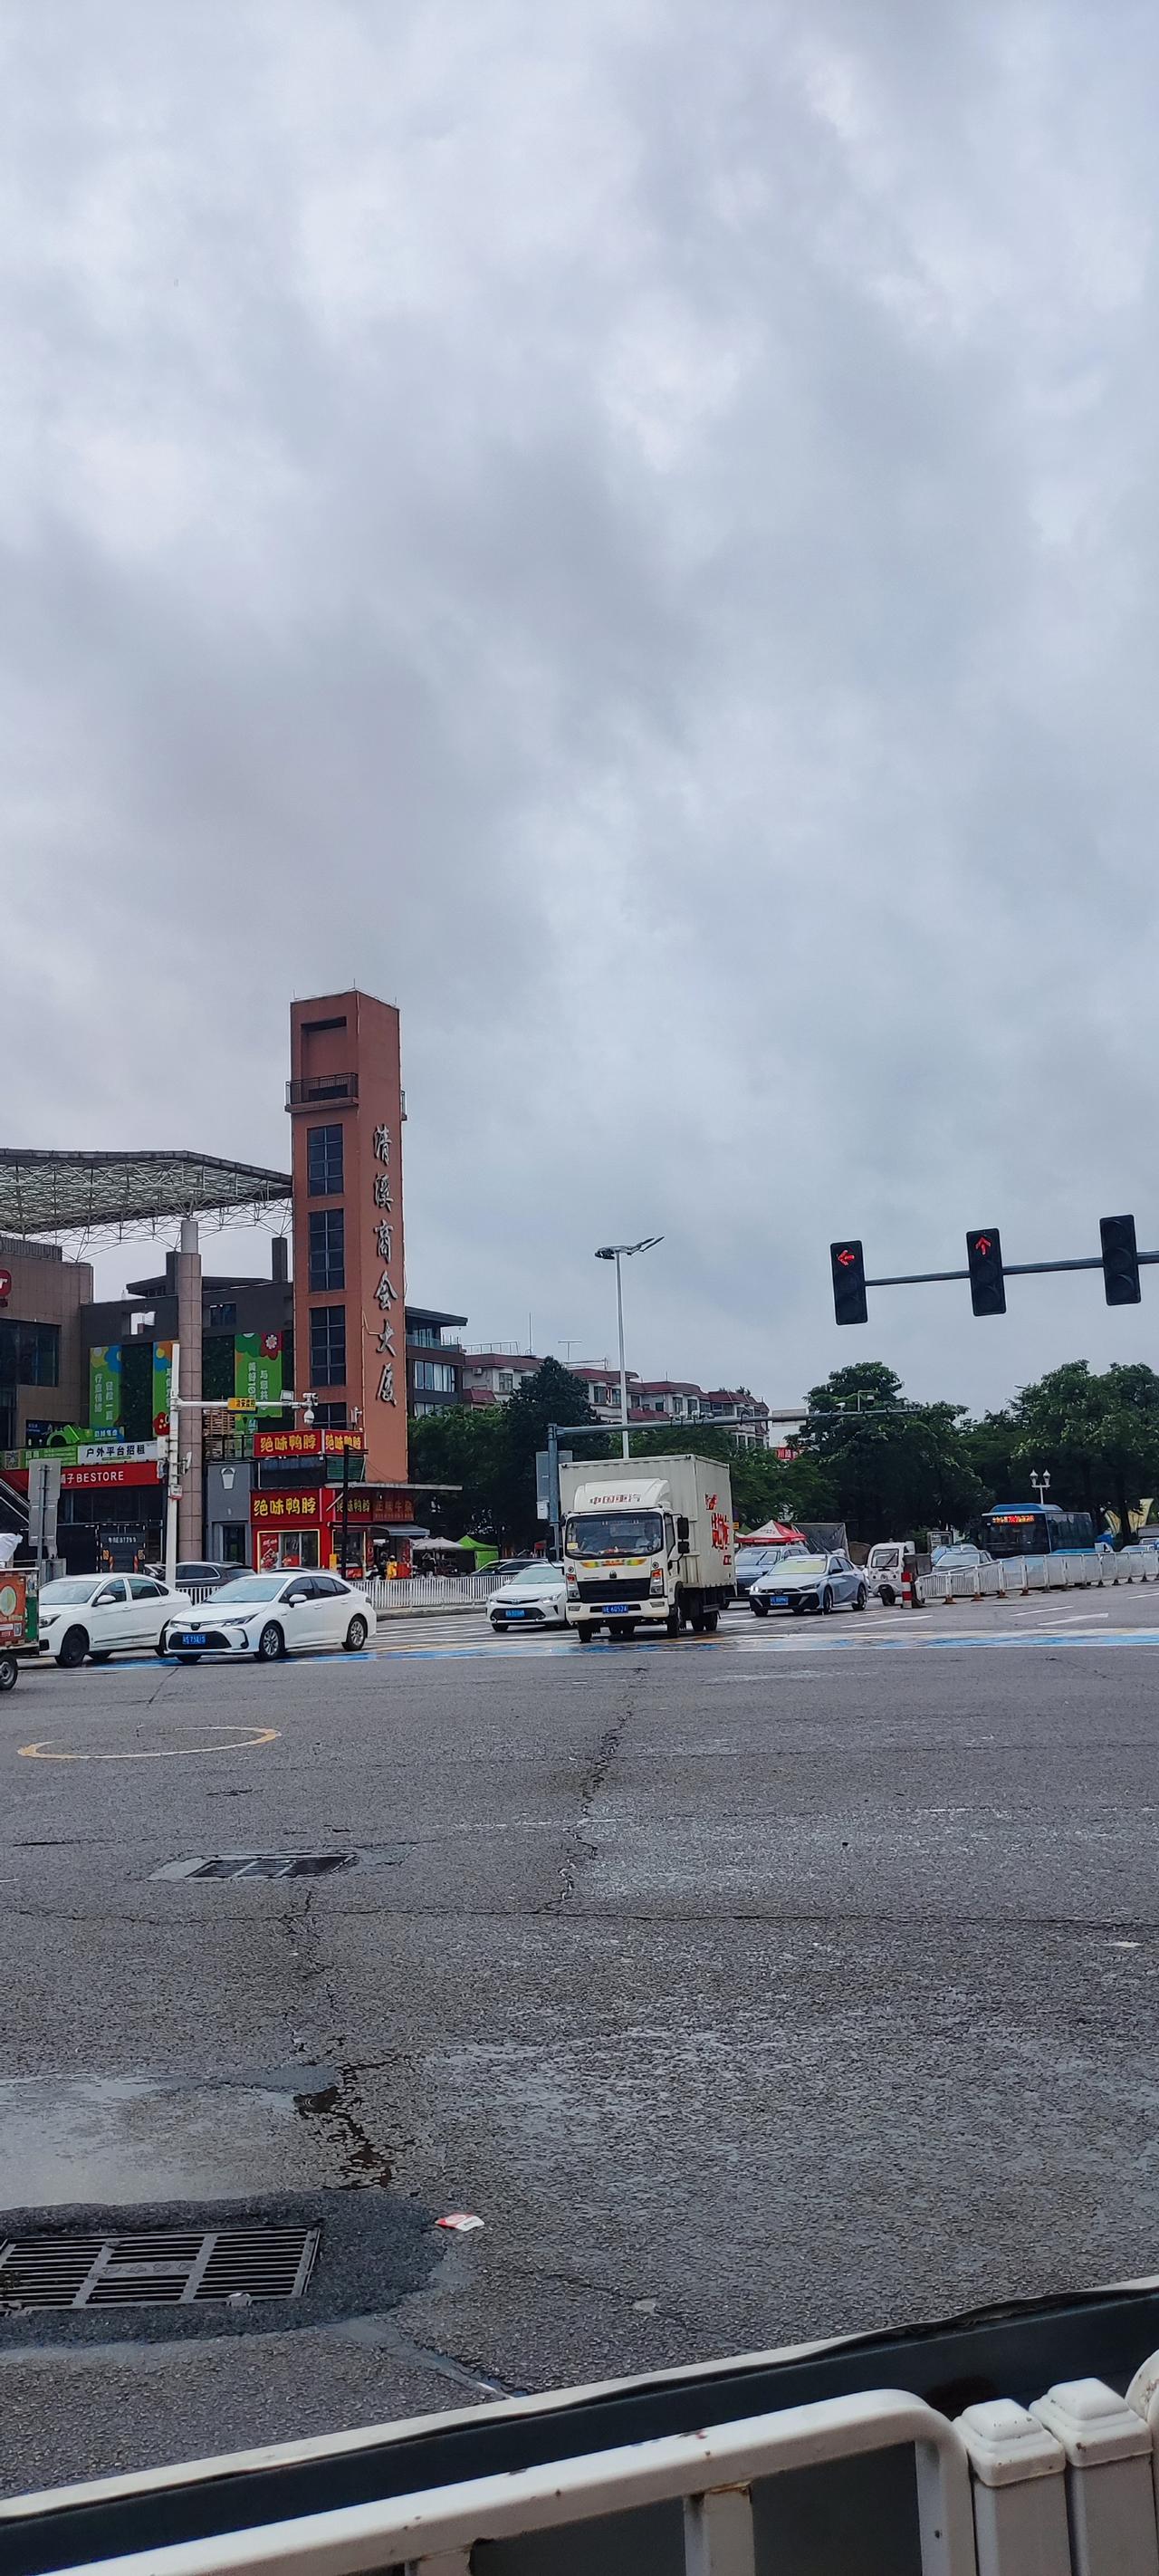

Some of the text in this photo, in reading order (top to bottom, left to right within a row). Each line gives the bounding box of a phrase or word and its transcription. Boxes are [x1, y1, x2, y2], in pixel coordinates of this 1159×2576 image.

[372, 1123, 398, 1405] 清溪商会大厦
[86, 1444, 145, 1457] 户外平台招租
[260, 1434, 316, 1452] 绝味鸭脖
[76, 1471, 124, 1483] BESTORE
[254, 1496, 316, 1516] 绝味鸭脖
